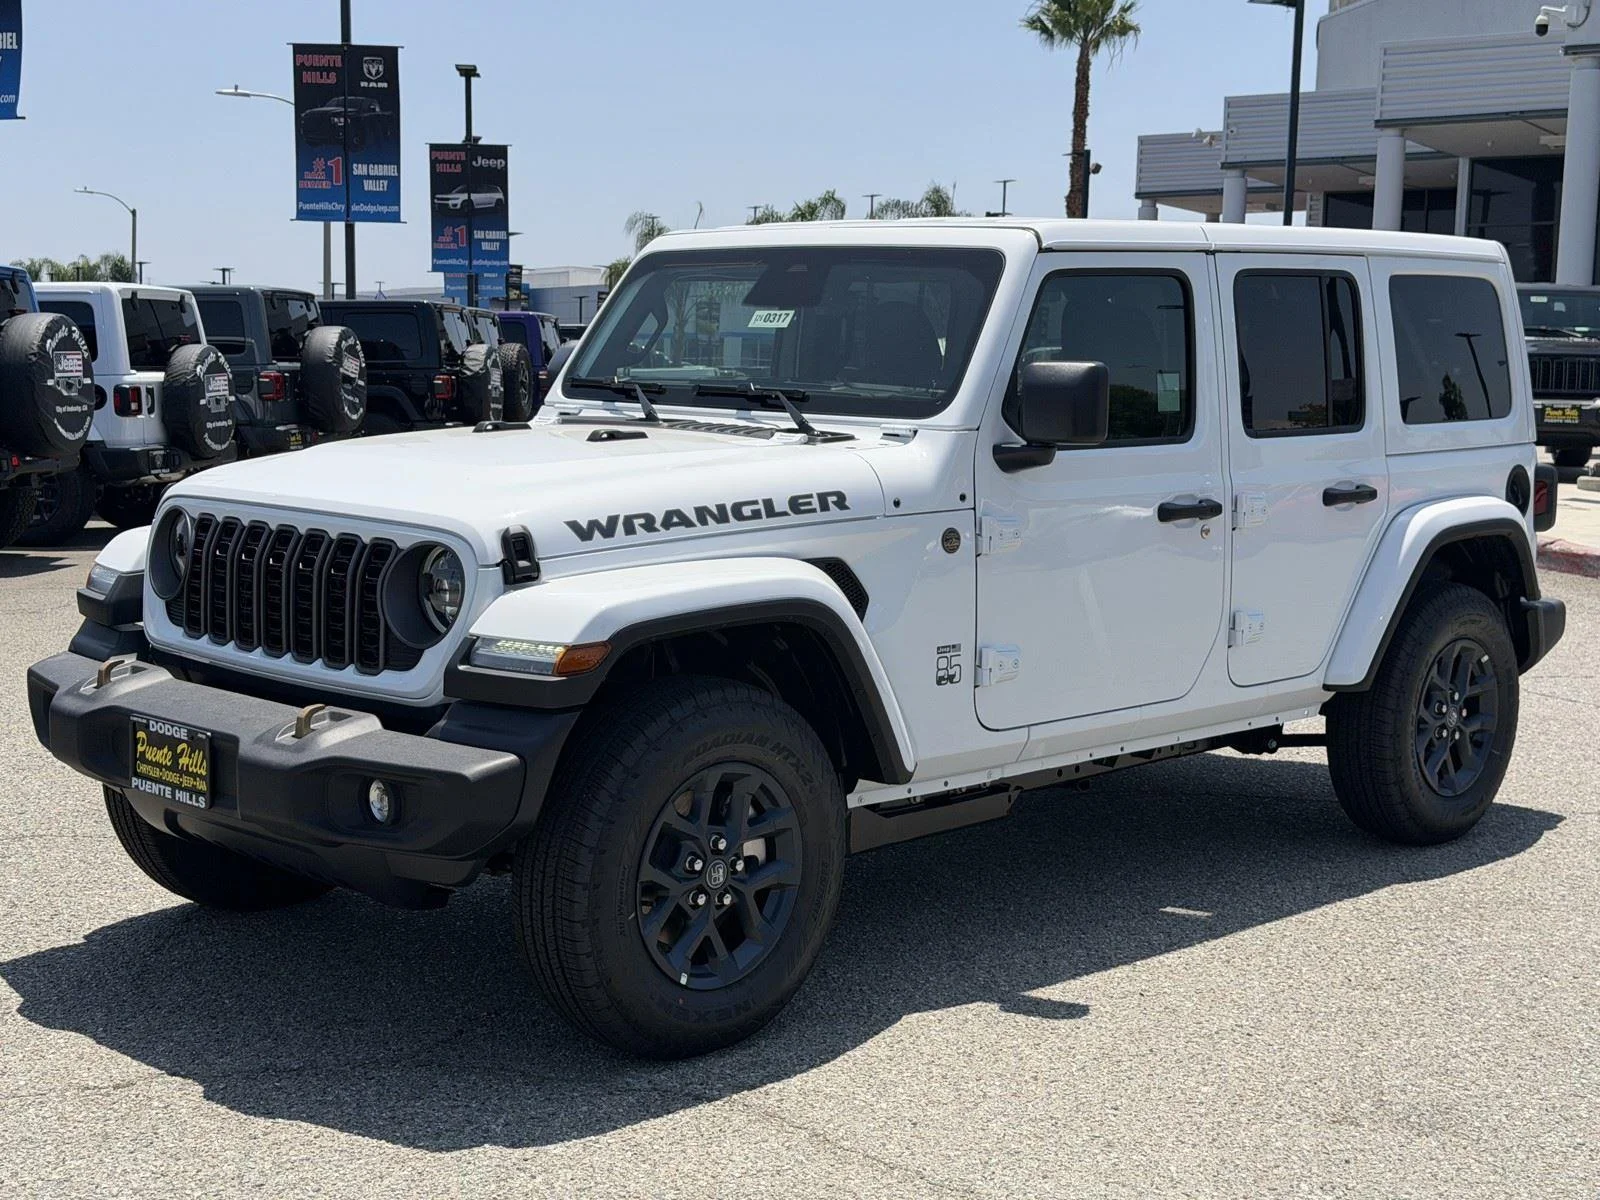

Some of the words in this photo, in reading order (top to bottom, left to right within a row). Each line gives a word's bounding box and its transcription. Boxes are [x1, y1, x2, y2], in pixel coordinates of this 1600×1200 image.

[295, 54, 342, 67] PUENTE
[302, 71, 337, 84] HILLS
[436, 163, 462, 173] HILLS
[472, 155, 506, 170] Jeep
[352, 163, 367, 176] SAN
[368, 164, 398, 177] GABRIEL
[363, 180, 388, 192] VALLEY
[481, 241, 500, 251] VALLEY
[763, 313, 790, 323] 0317
[563, 490, 850, 542] WRANGLER
[149, 719, 189, 740] DODGE
[136, 730, 173, 767] Puente
[177, 743, 207, 776] Hills
[131, 777, 172, 799] PUENTE
[175, 789, 206, 809] HILLS
